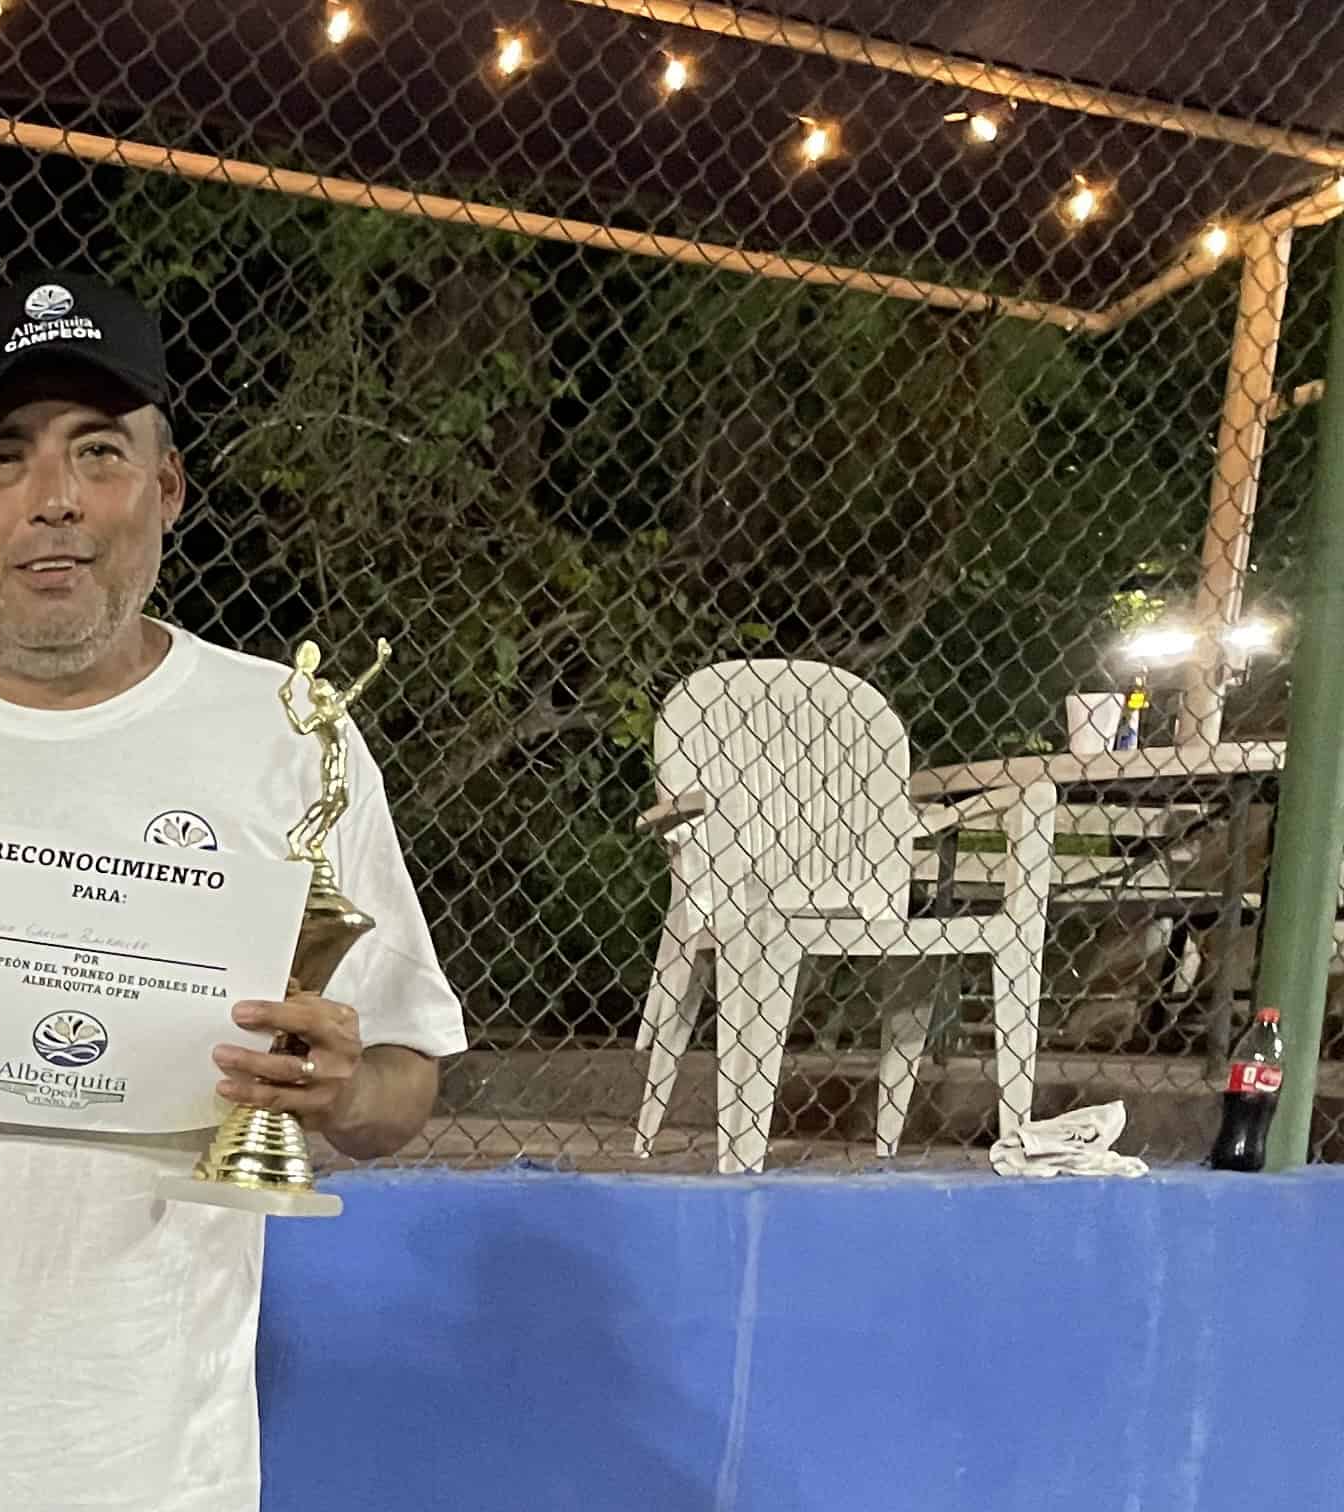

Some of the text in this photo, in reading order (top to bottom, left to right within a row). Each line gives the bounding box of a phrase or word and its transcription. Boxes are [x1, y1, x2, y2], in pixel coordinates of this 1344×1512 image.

[71, 884, 127, 904] PARA:
[74, 953, 99, 965] POR
[22, 974, 140, 1000] ALBERQUITA OPEN
[34, 961, 58, 974] DEL
[62, 965, 114, 982] TORNEO
[118, 974, 135, 985] DE
[138, 977, 188, 992] DOBLES
[192, 984, 208, 995] DE
[212, 986, 227, 998] LA
[39, 1085, 78, 1099] Open
